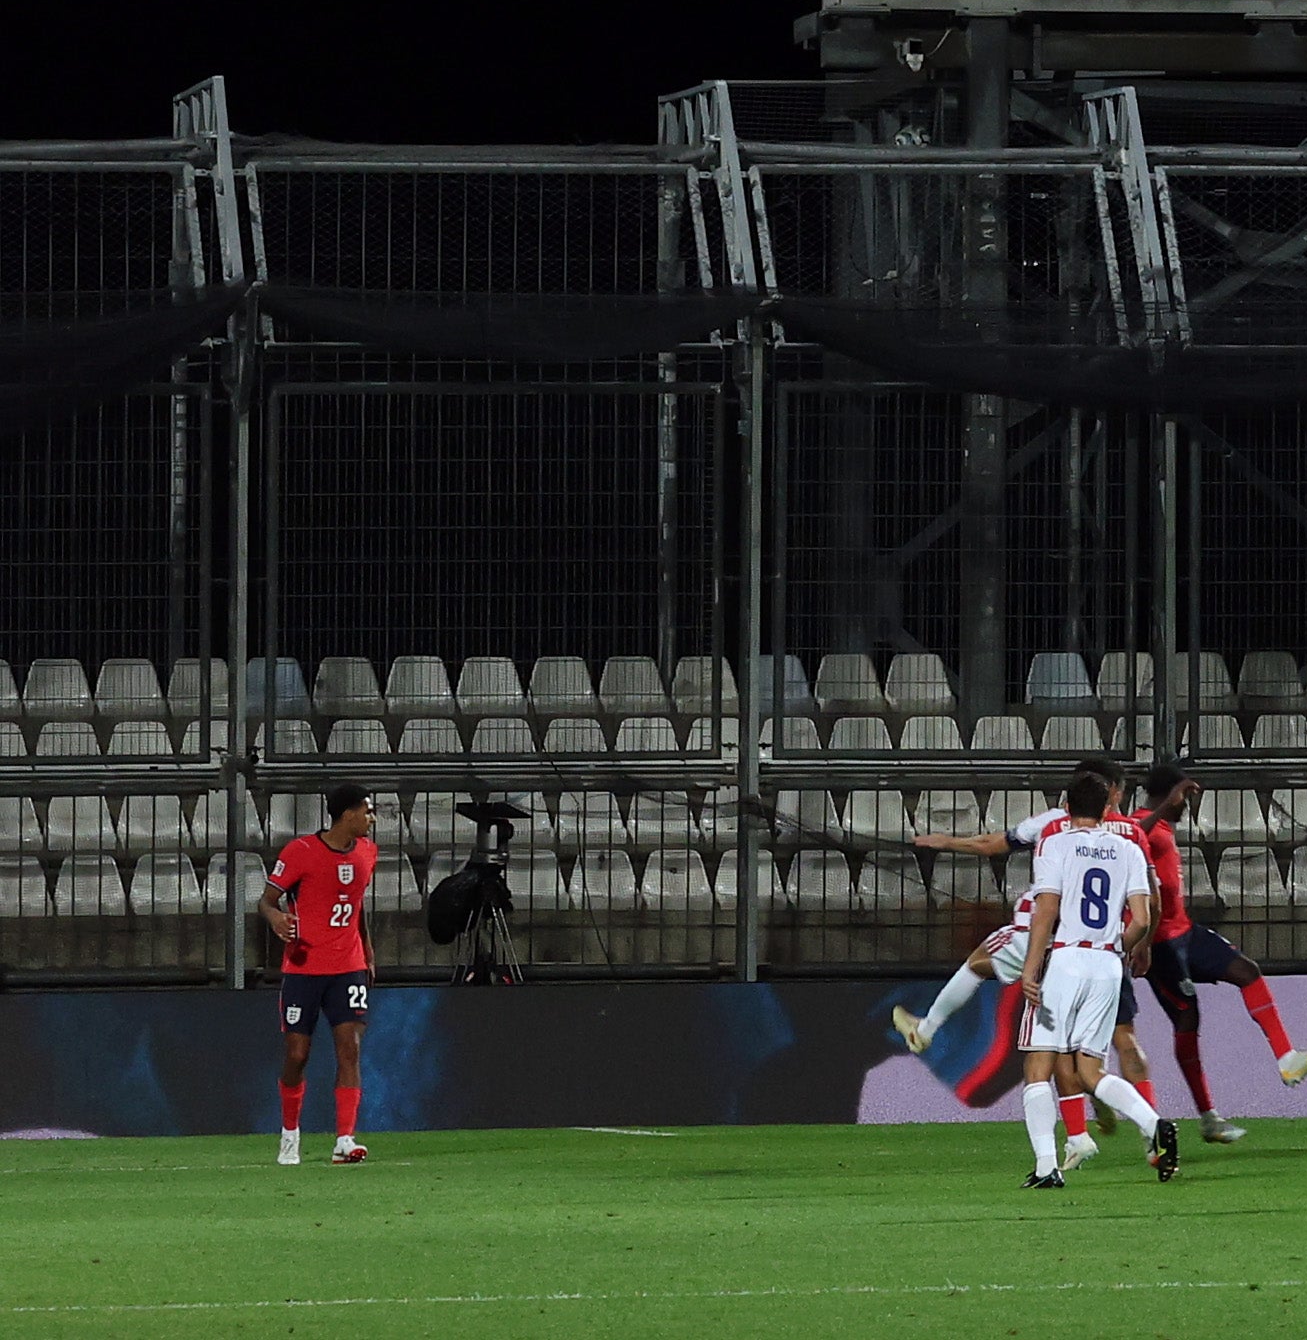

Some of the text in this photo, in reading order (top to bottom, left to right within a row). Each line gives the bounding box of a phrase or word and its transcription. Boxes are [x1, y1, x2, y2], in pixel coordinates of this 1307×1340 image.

[1080, 867, 1111, 929] 8
[330, 903, 353, 927] 22
[348, 984, 368, 1009] 22
